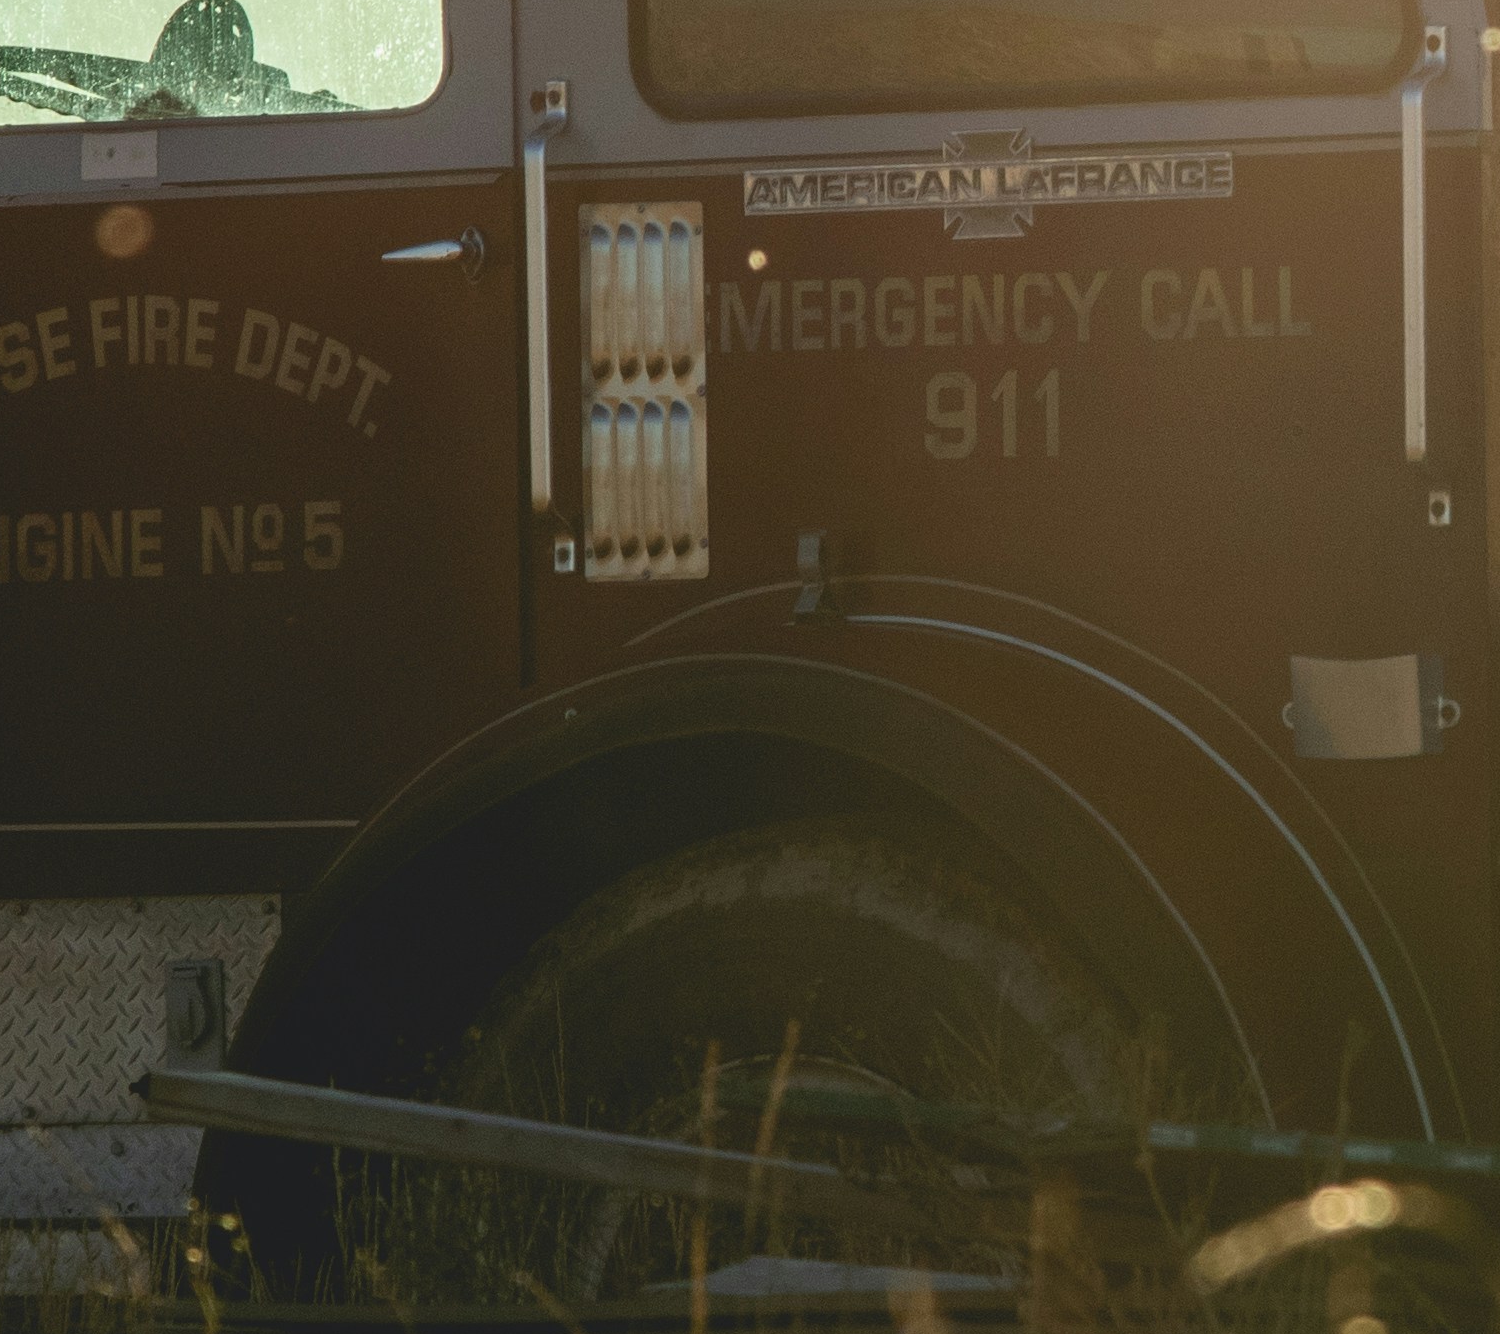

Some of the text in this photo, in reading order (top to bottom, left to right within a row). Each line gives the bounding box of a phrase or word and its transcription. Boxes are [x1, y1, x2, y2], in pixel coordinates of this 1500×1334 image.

[747, 167, 982, 208] AMERICAN
[704, 266, 1312, 354] MERGENCY CALL
[88, 294, 220, 368] FIRE
[233, 307, 394, 439] DEPT.
[924, 369, 1061, 460] 911
